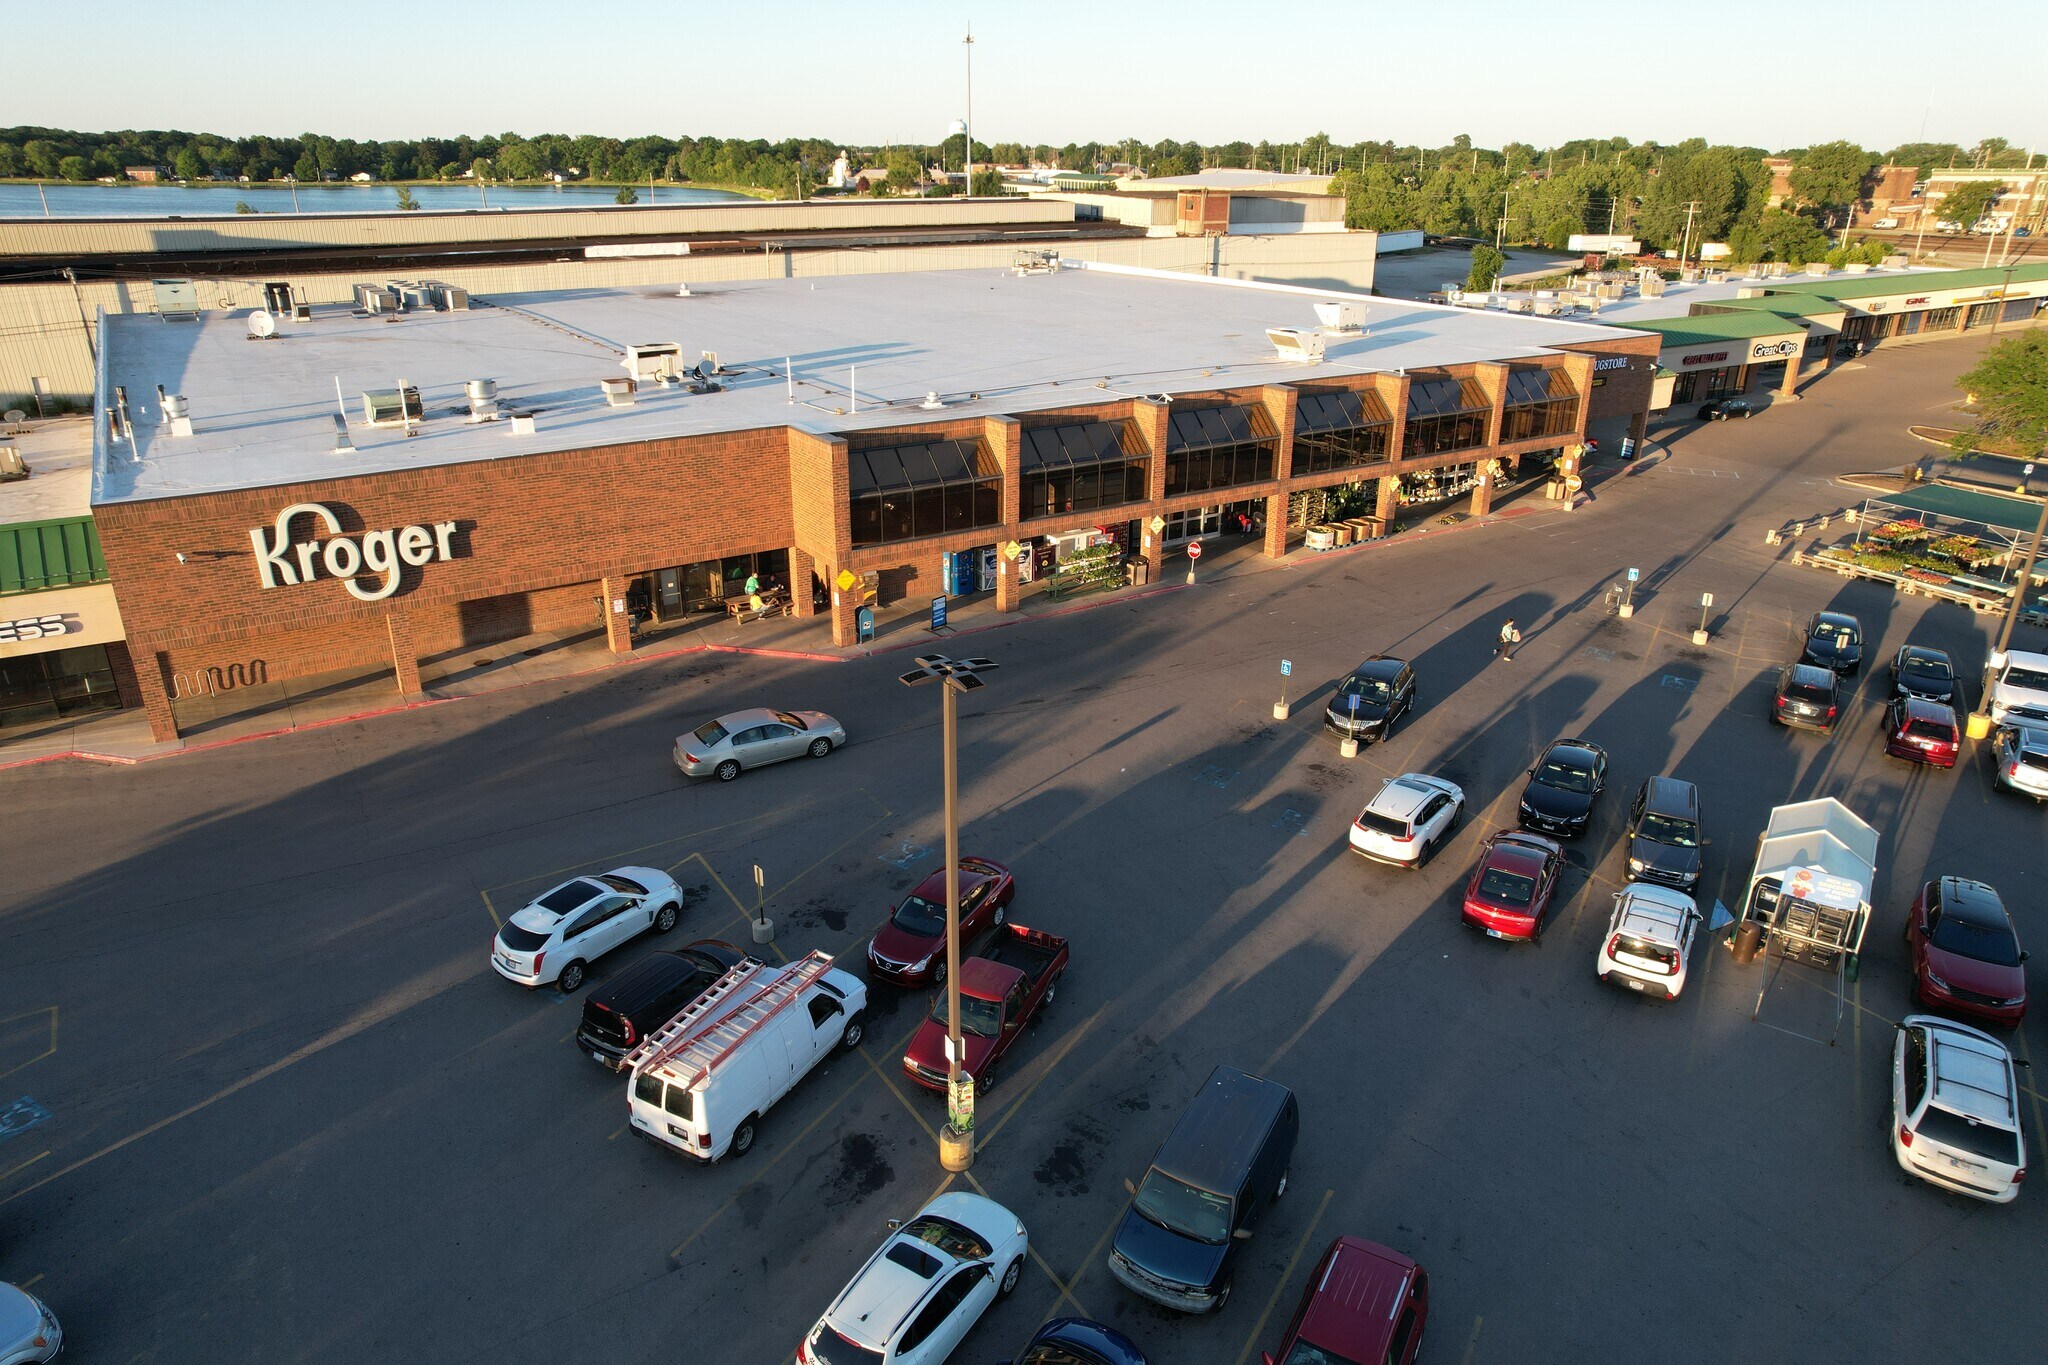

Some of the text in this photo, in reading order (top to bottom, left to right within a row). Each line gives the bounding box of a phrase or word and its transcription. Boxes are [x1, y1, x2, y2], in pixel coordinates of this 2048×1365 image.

[1906, 297, 1931, 305] GNC
[1753, 340, 1798, 357] Great Clips
[249, 502, 457, 602] Kroger
